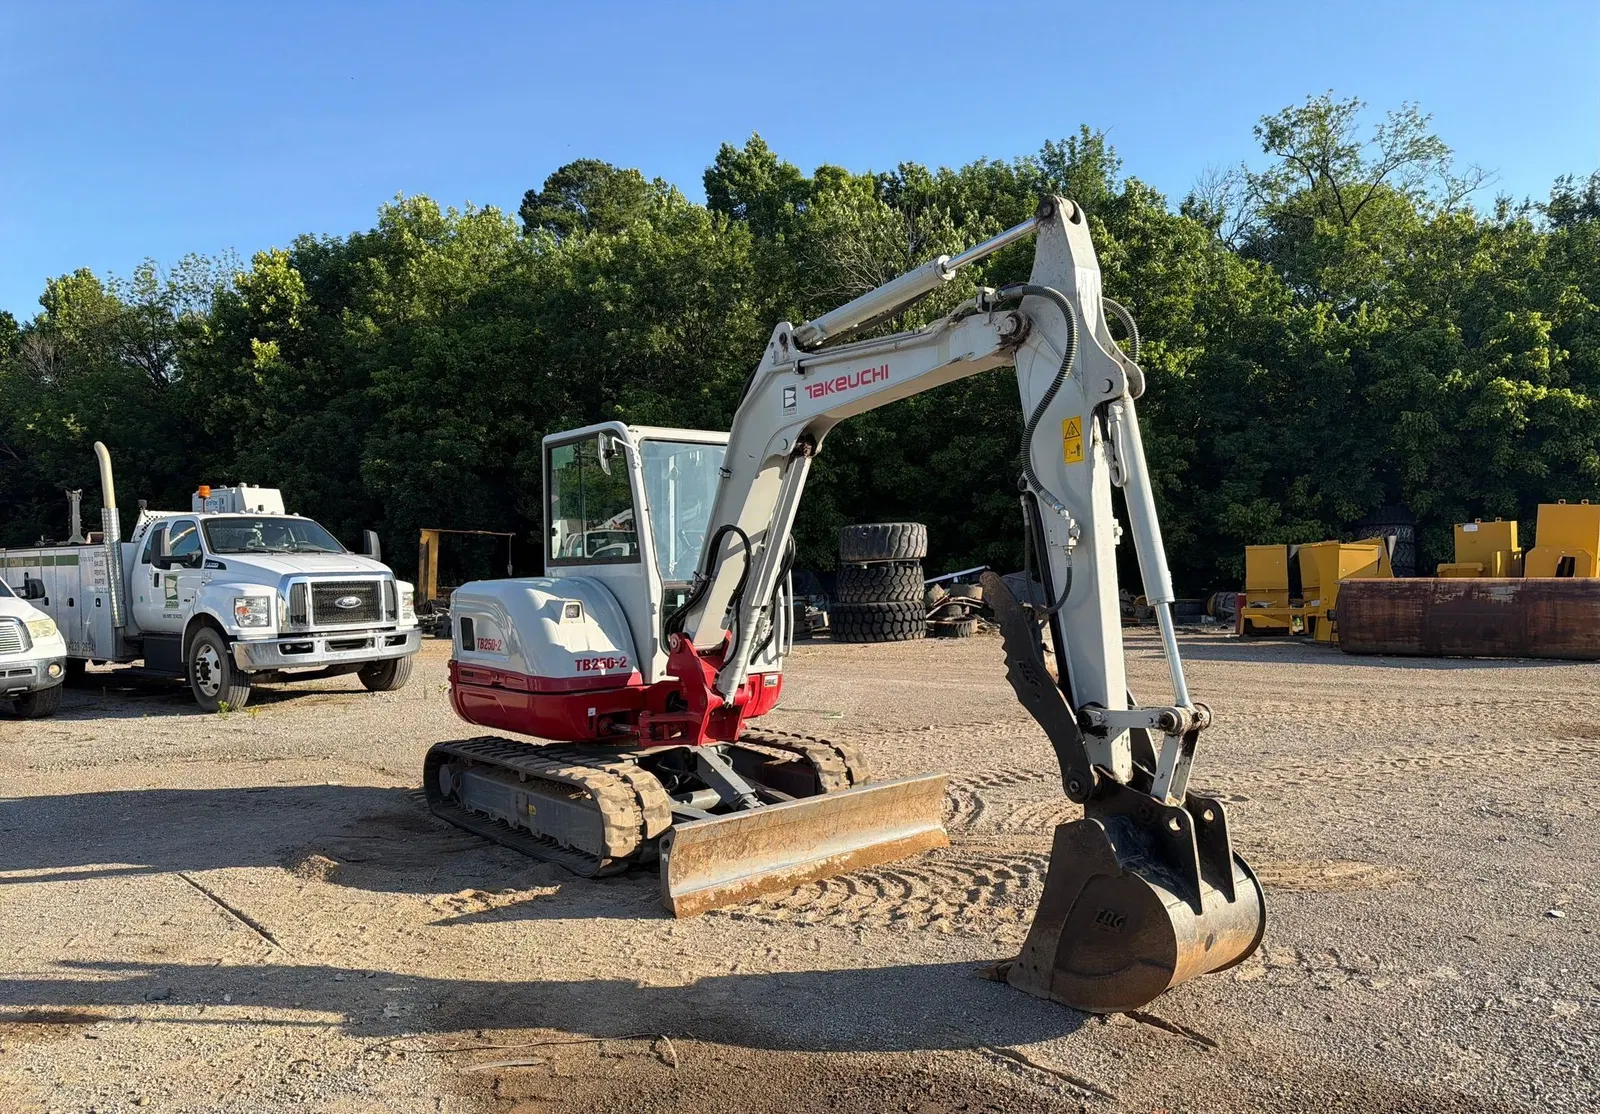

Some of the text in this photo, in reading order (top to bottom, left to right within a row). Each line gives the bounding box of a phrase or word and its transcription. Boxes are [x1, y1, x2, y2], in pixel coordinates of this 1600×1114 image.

[805, 364, 889, 399] TAKEUCHI
[477, 637, 502, 651] TB250-2
[575, 656, 627, 672] TB250-2
